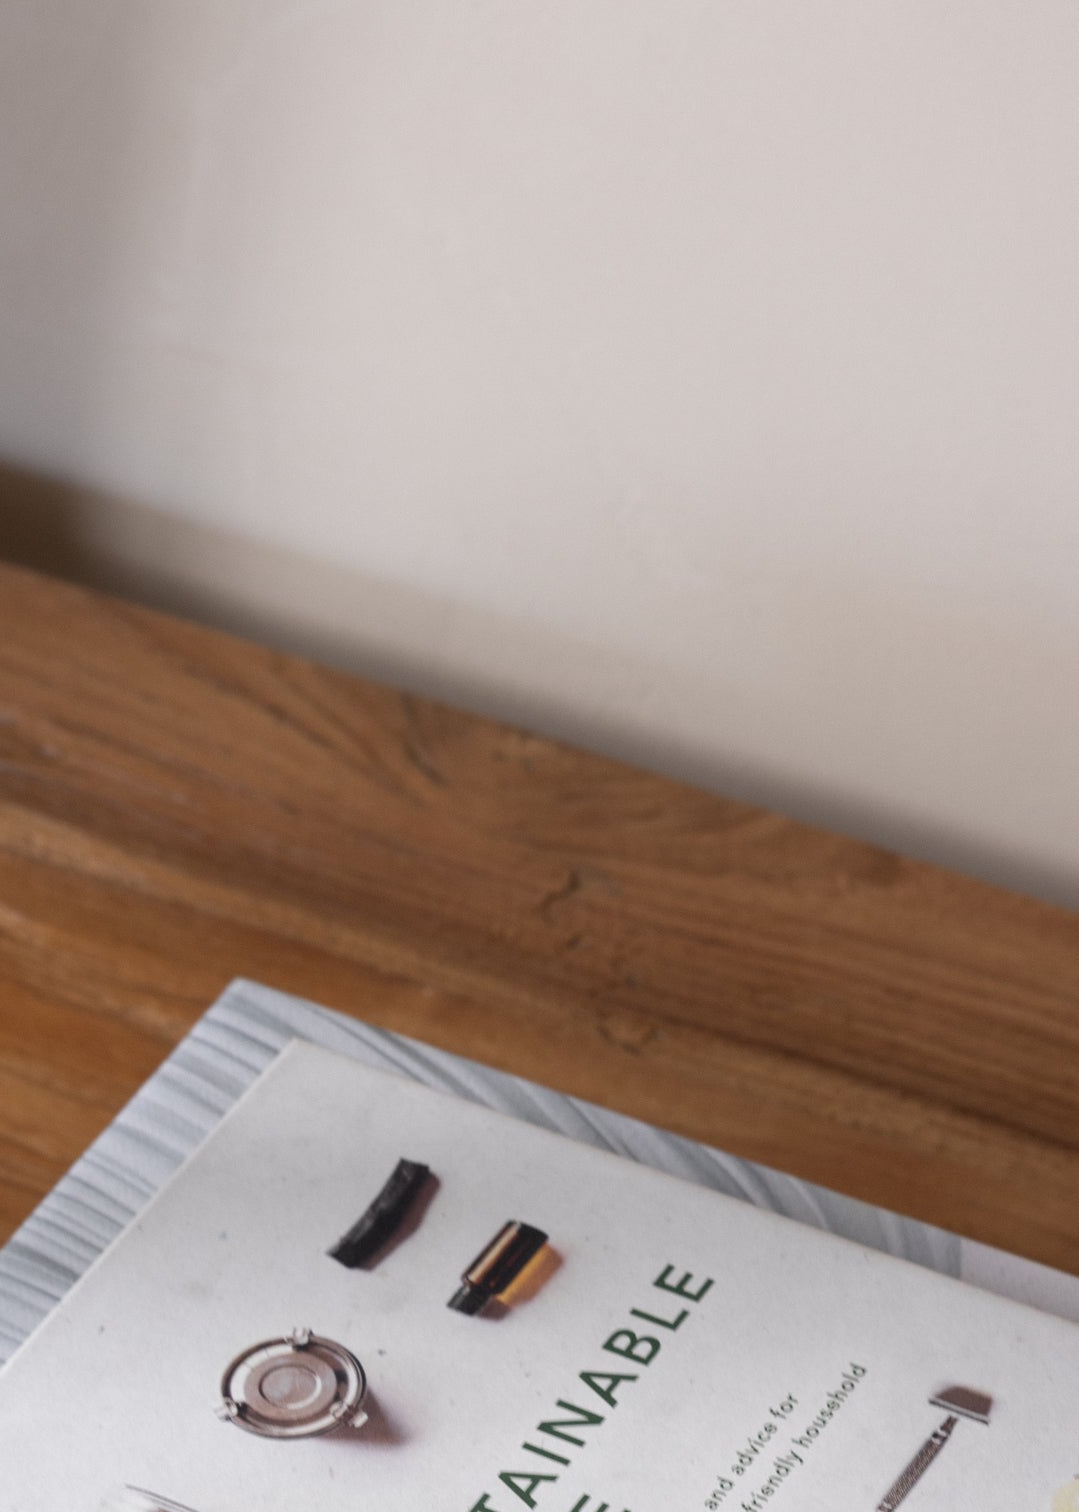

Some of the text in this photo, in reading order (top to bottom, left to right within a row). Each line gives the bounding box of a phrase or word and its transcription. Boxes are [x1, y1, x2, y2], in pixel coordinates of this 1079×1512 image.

[705, 1476, 735, 1512] and
[731, 1422, 778, 1477] advice
[769, 1393, 799, 1420] for
[791, 1361, 868, 1449] household
